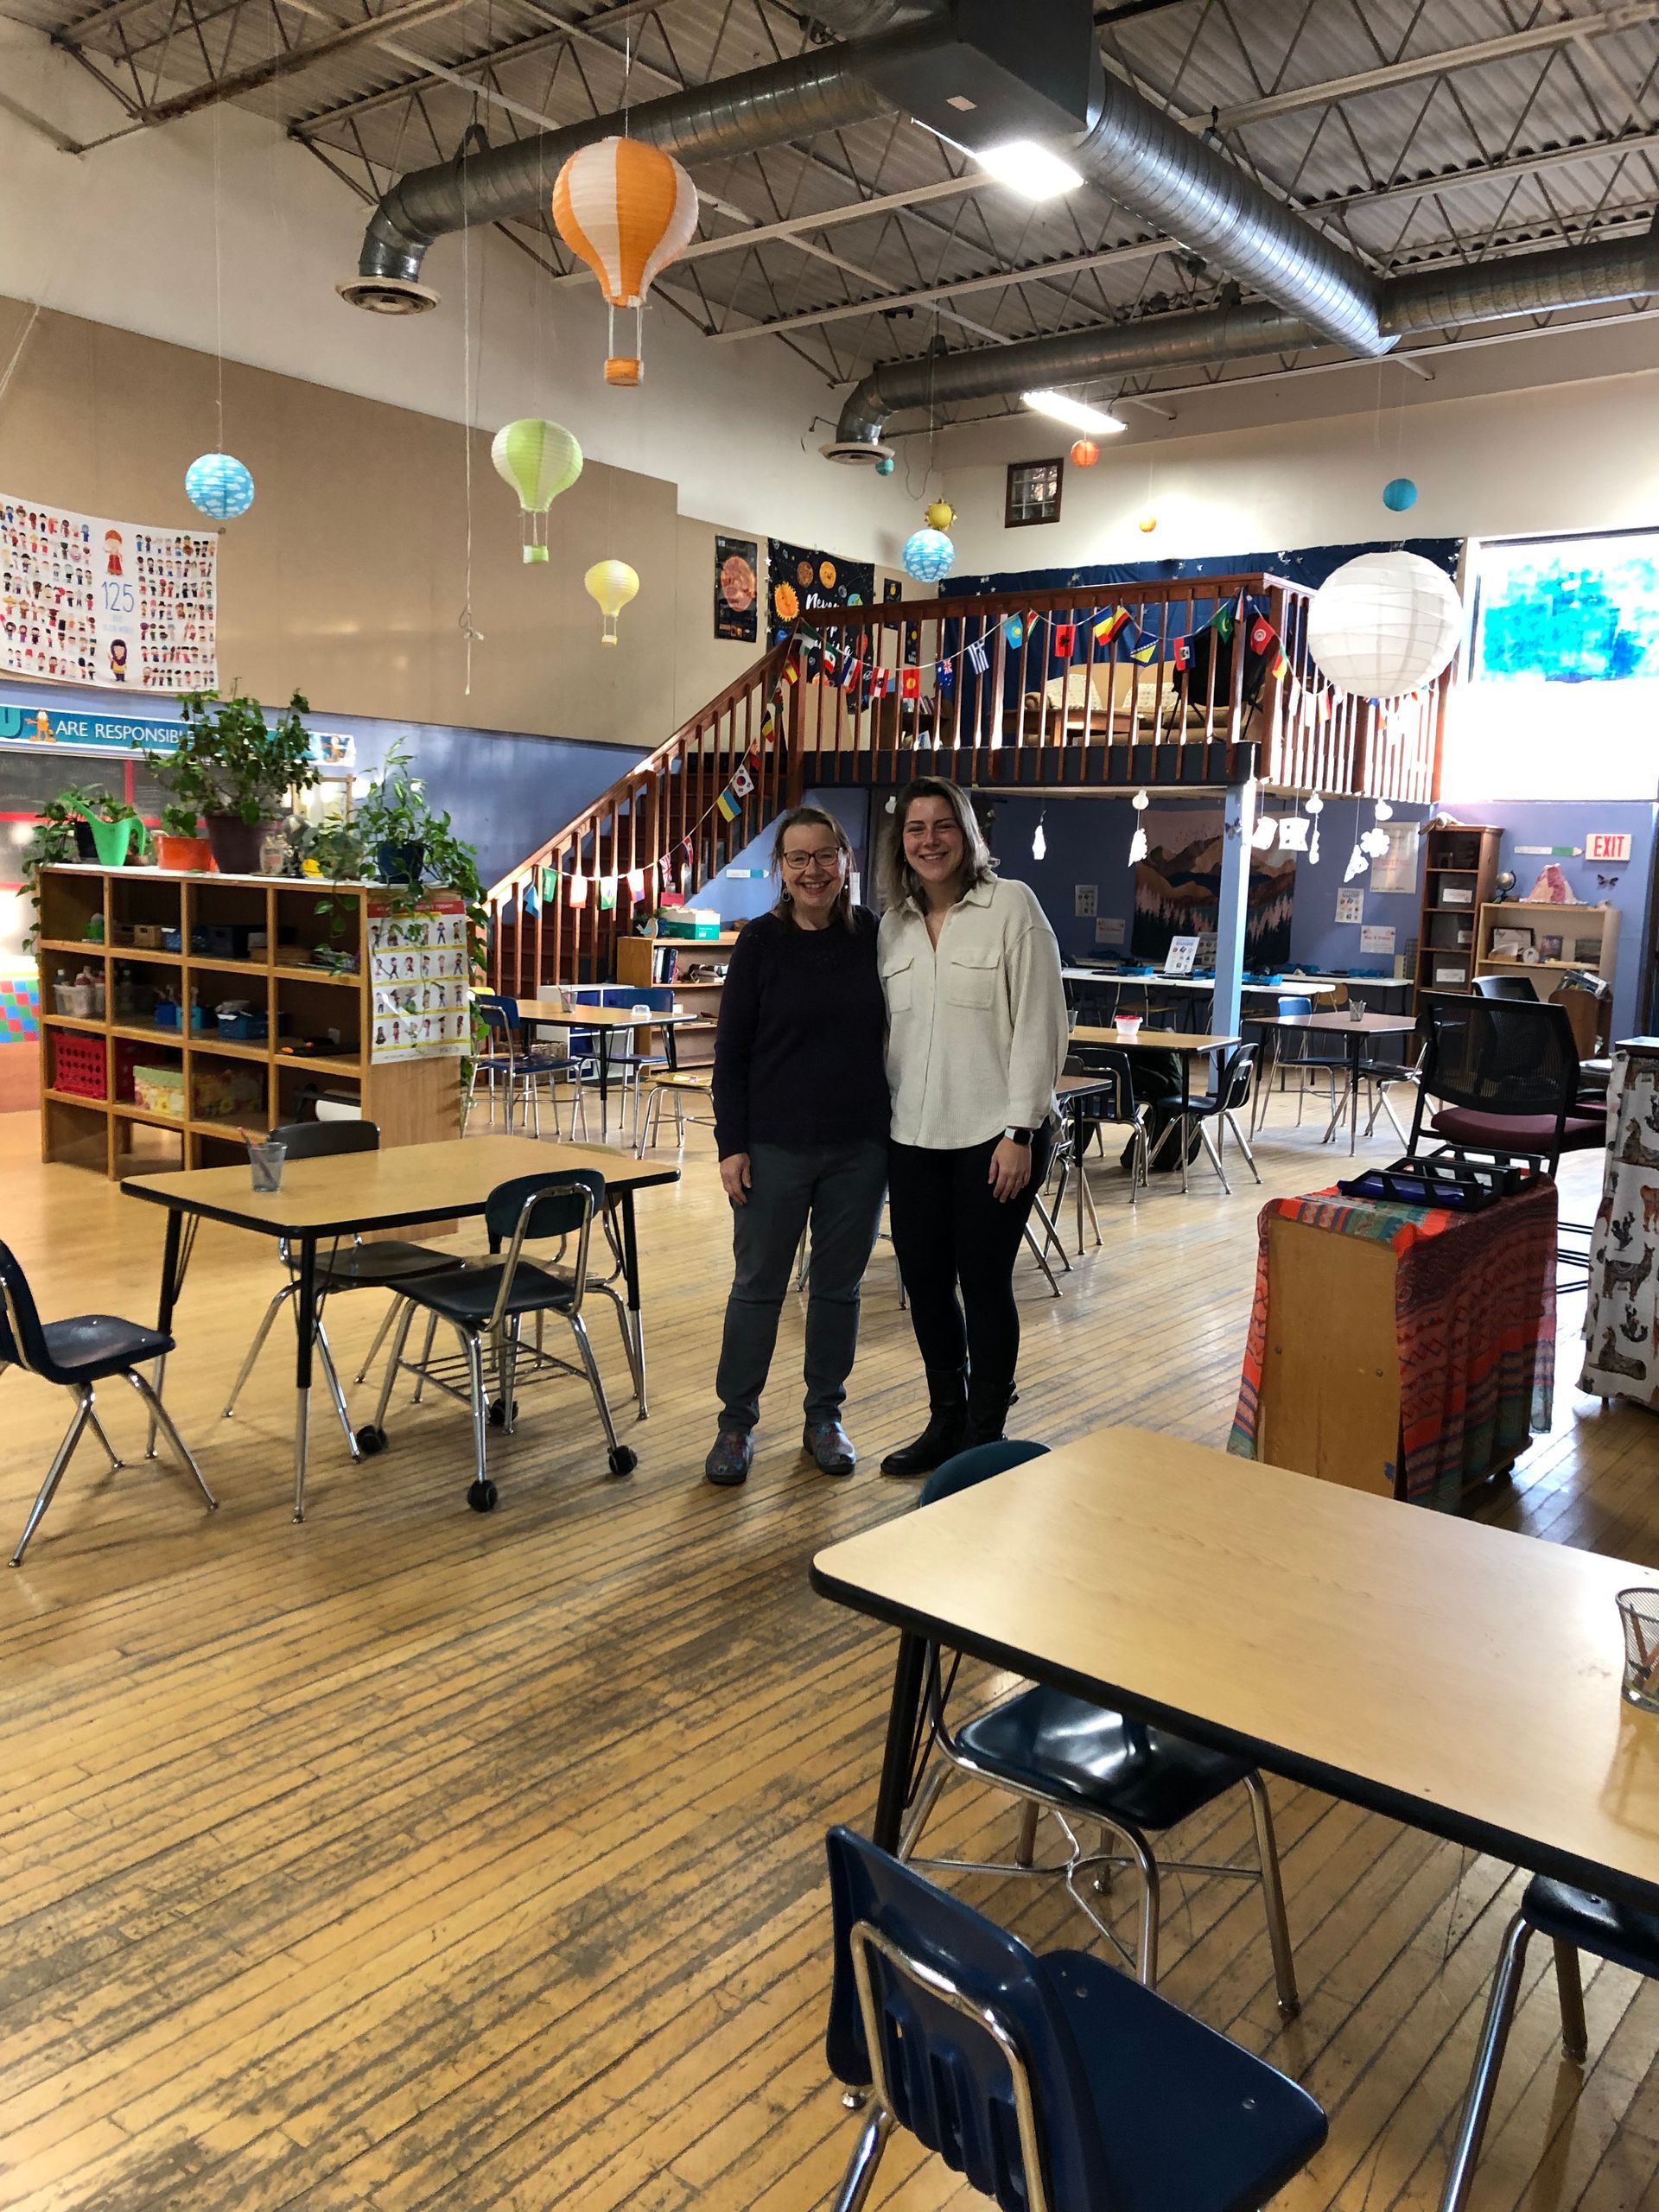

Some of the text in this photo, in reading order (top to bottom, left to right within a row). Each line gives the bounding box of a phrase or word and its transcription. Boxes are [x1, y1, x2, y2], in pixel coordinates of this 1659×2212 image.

[101, 582, 134, 613] 125
[56, 720, 88, 737] ARE
[1593, 836, 1624, 858] EXIT
